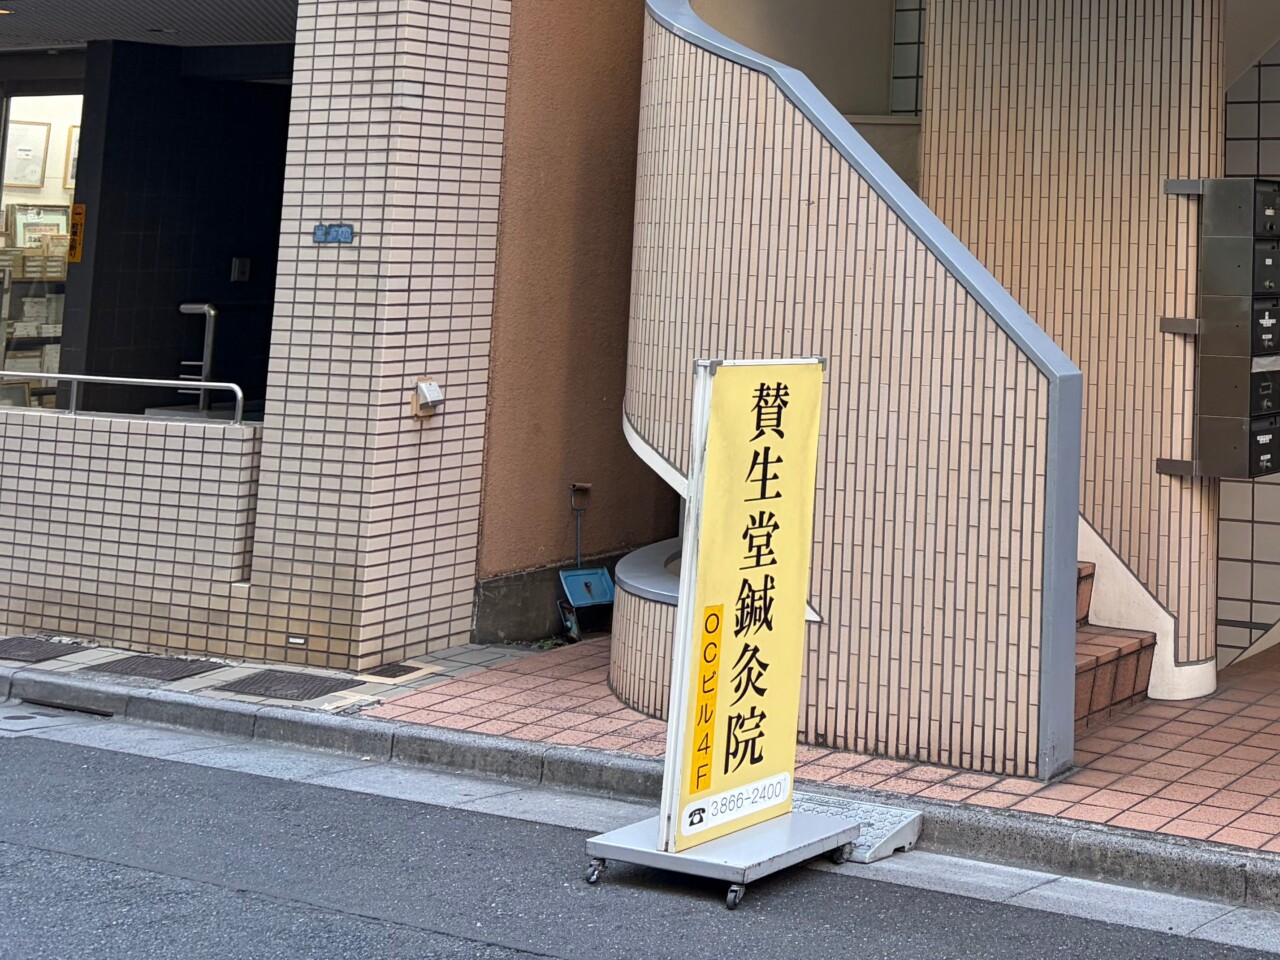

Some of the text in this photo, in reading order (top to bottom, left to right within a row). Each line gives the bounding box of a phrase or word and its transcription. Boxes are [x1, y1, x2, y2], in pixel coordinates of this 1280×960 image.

[723, 382, 791, 777] 賛生堂鍼灸院
[694, 611, 721, 791] OCビル4F
[710, 781, 782, 817] 3866-2400
